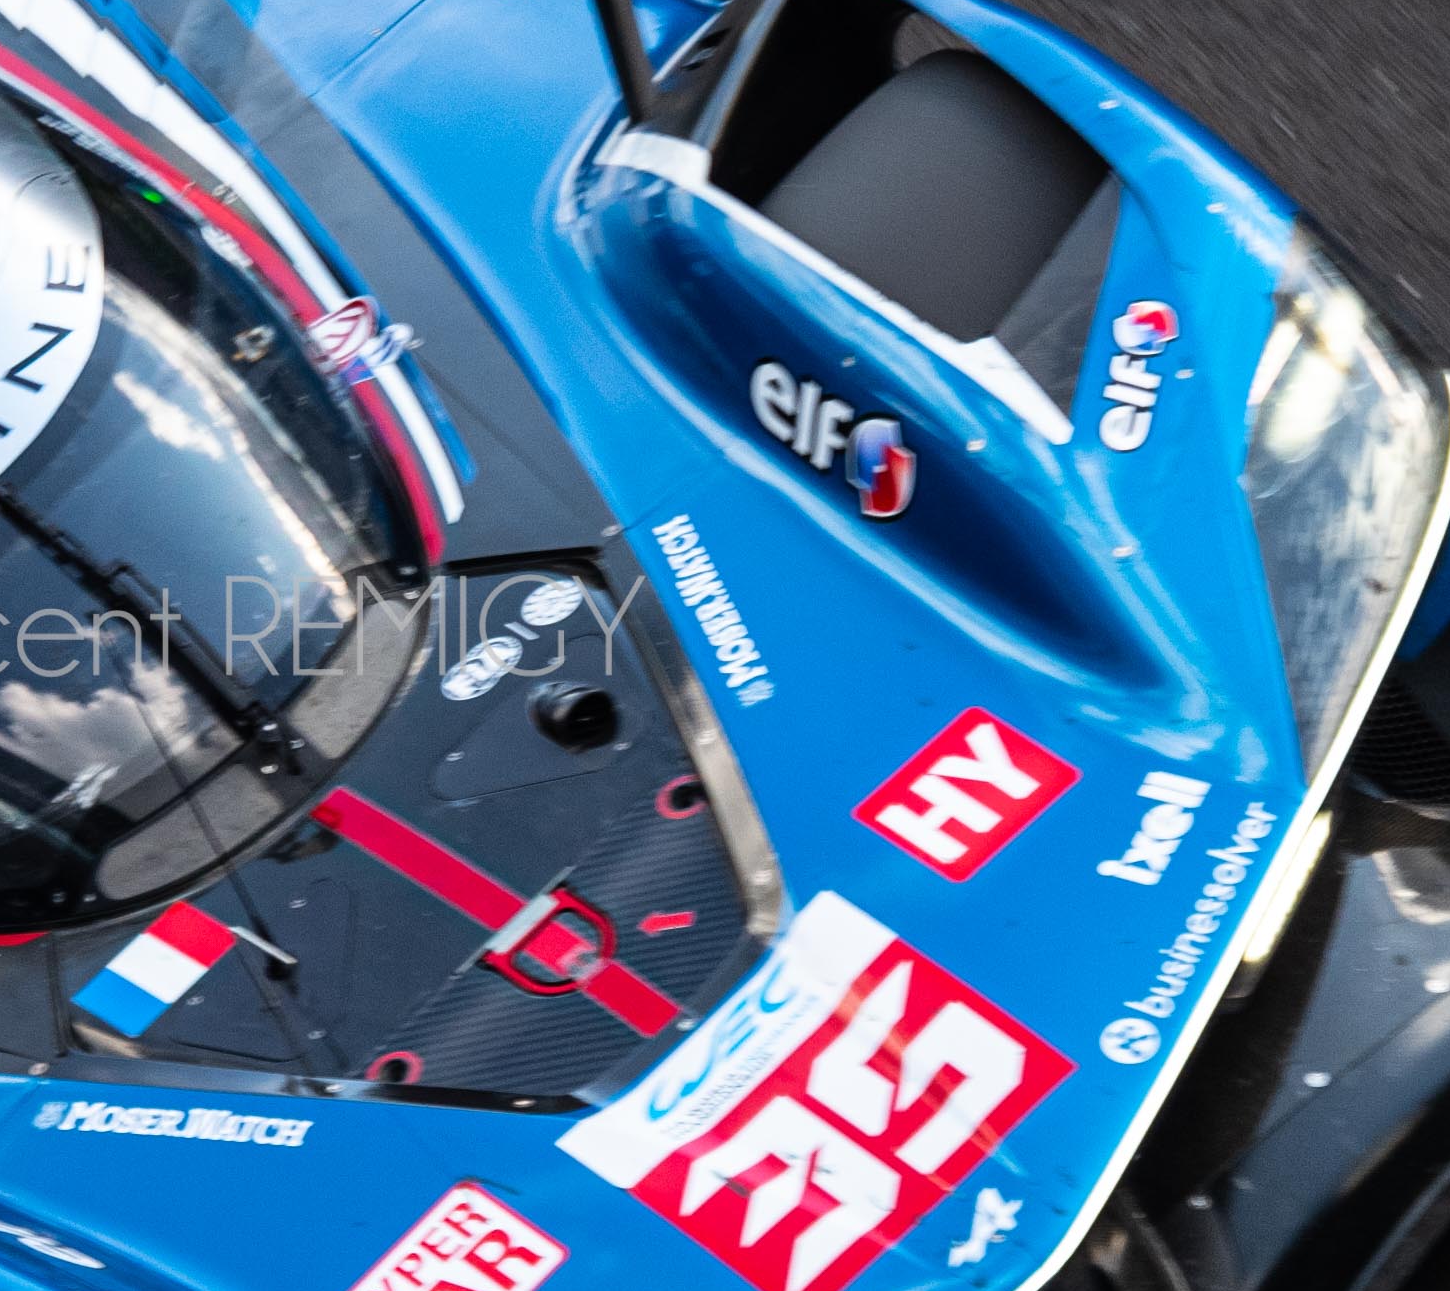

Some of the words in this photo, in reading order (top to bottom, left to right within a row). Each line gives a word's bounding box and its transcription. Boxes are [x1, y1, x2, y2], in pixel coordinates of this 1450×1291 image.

[750, 360, 853, 470] elf
[1099, 354, 1162, 452] elf
[875, 721, 1041, 865] HY
[1098, 771, 1211, 885] ixell
[1124, 801, 1278, 1020] businessolver
[646, 958, 798, 1121] WEC
